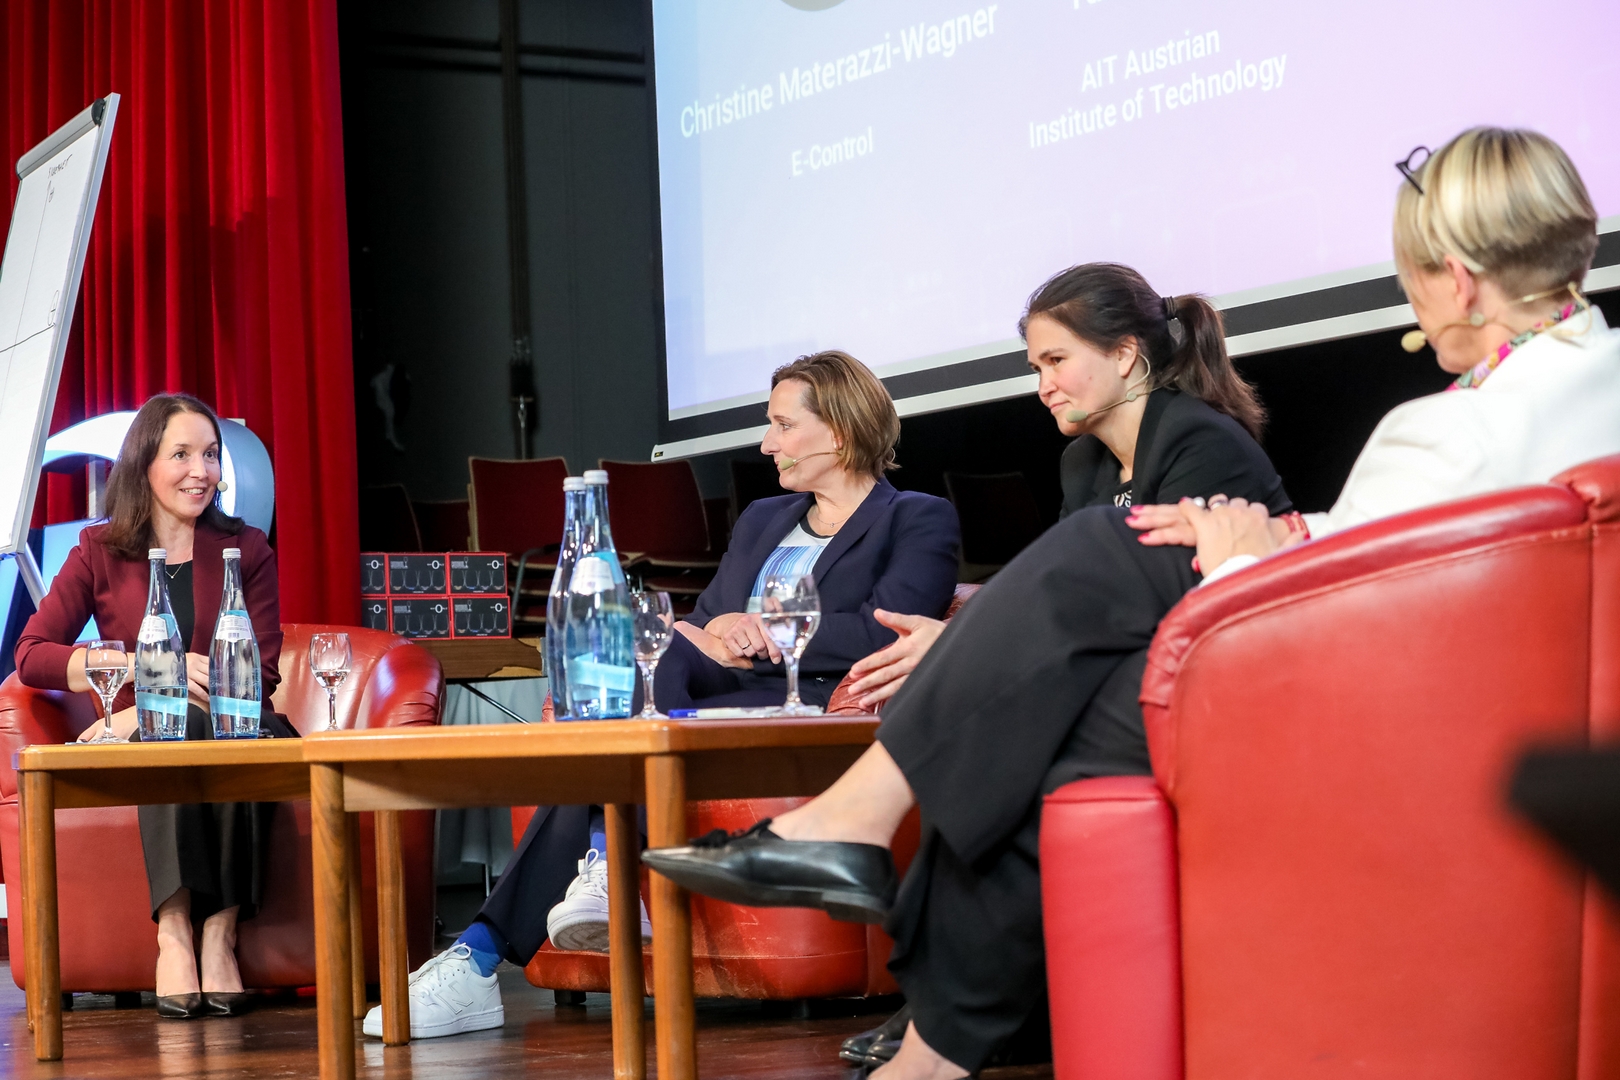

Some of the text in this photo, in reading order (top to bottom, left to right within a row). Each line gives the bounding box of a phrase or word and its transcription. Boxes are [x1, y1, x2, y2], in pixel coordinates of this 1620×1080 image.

[680, 4, 998, 139] Christine Materazzi-Wagner
[1081, 29, 1220, 92] AIT Austrian
[1028, 54, 1288, 149] Institute of Technology
[791, 126, 874, 177] E-Control
